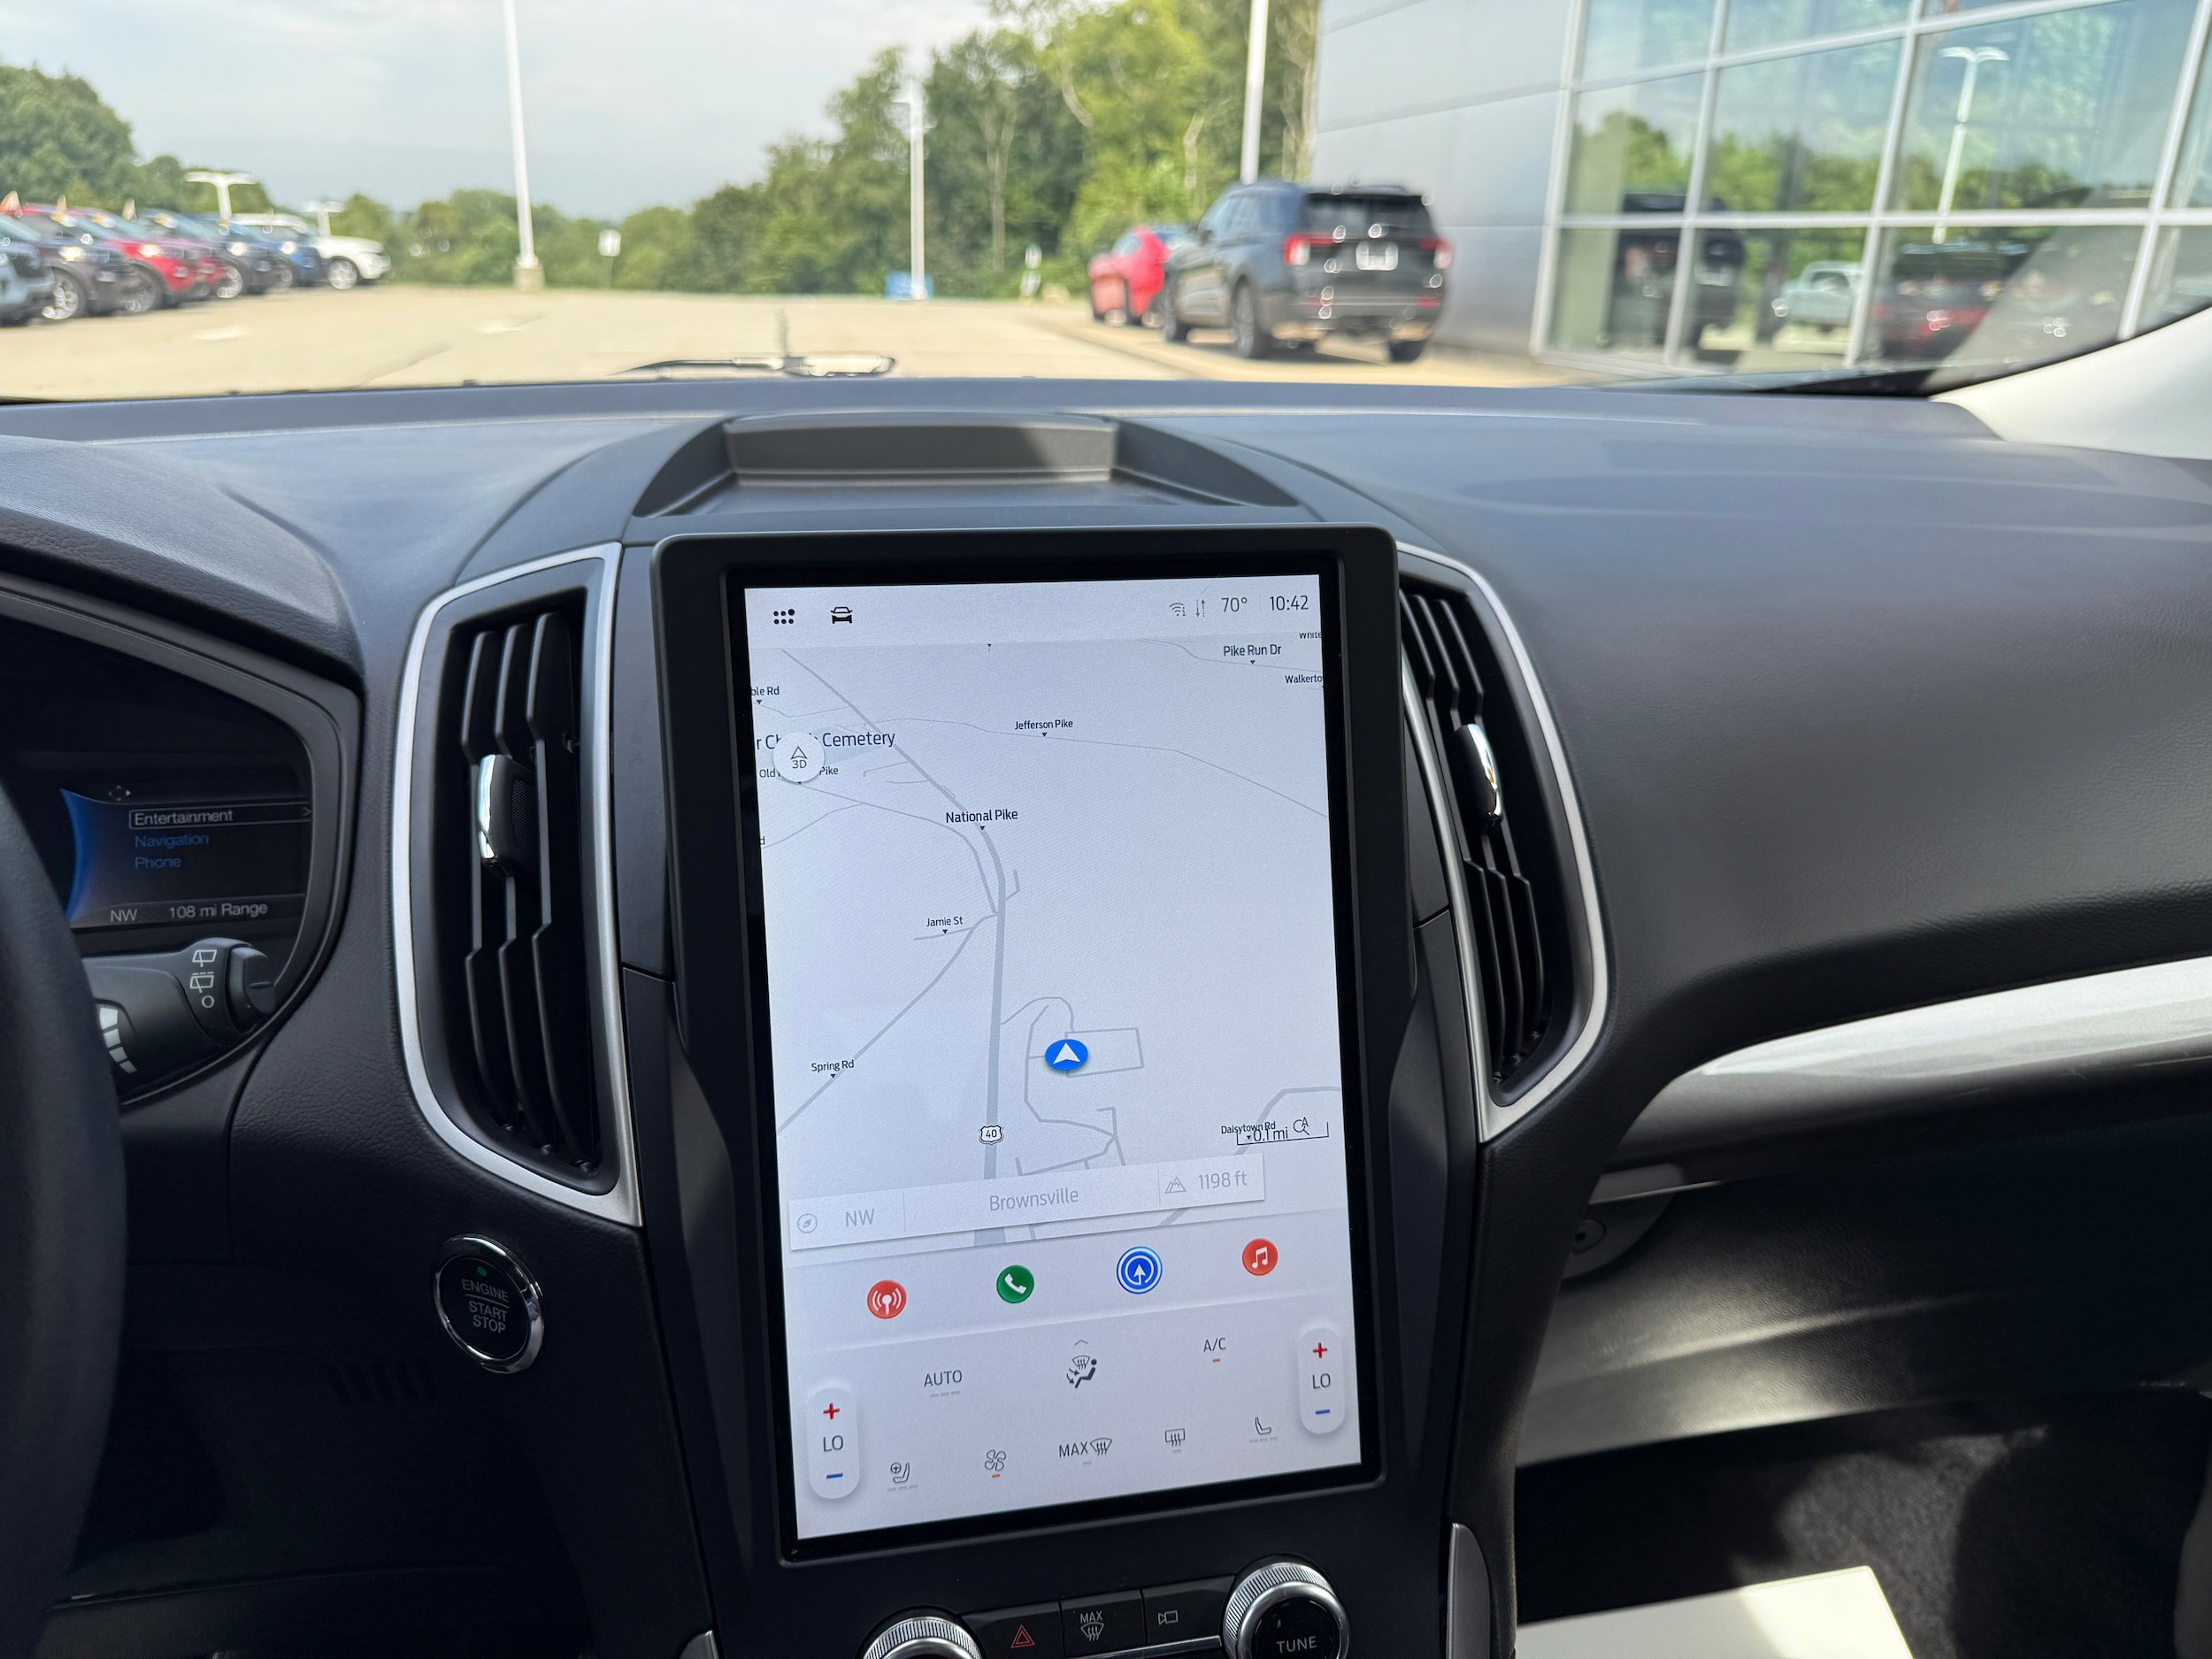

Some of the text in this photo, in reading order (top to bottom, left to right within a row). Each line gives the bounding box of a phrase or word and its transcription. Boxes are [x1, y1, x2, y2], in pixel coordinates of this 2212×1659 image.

[1221, 597, 1248, 613] 70°
[1270, 595, 1309, 611] 10:42
[1224, 644, 1281, 657] Pike Run Dr
[767, 686, 780, 695] Rd
[1014, 718, 1073, 730] Jefferson Pike
[822, 731, 895, 748] Cemetery
[759, 768, 776, 778] Old
[819, 766, 839, 776] Pike
[792, 759, 807, 769] 3D
[134, 810, 234, 826] Entertainment
[946, 809, 1018, 823] National Pike
[134, 833, 210, 849] Navigation
[134, 856, 182, 870] Phone
[110, 909, 138, 922] NW
[169, 902, 268, 919] 108 mi Range
[926, 916, 964, 927] Jamie St
[810, 1059, 855, 1073] Spring Rd
[986, 1129, 997, 1139] 40
[1221, 1120, 1276, 1134] Daisytown Rd
[1253, 1126, 1288, 1142] 0.1 mi
[1198, 1171, 1248, 1190] 1198 ft
[989, 1187, 1079, 1211] Brownsville
[845, 1209, 875, 1227] NW
[461, 1279, 510, 1303] ENGINE
[469, 1301, 508, 1323] START
[472, 1314, 506, 1333] STOP
[1202, 1337, 1226, 1353] A/C
[924, 1370, 963, 1387] AUTO
[1312, 1372, 1332, 1389] LO
[823, 1434, 844, 1452] LO
[1058, 1441, 1088, 1458] MAX
[1079, 1610, 1103, 1623] MAX
[1276, 1636, 1317, 1654] TUNE
